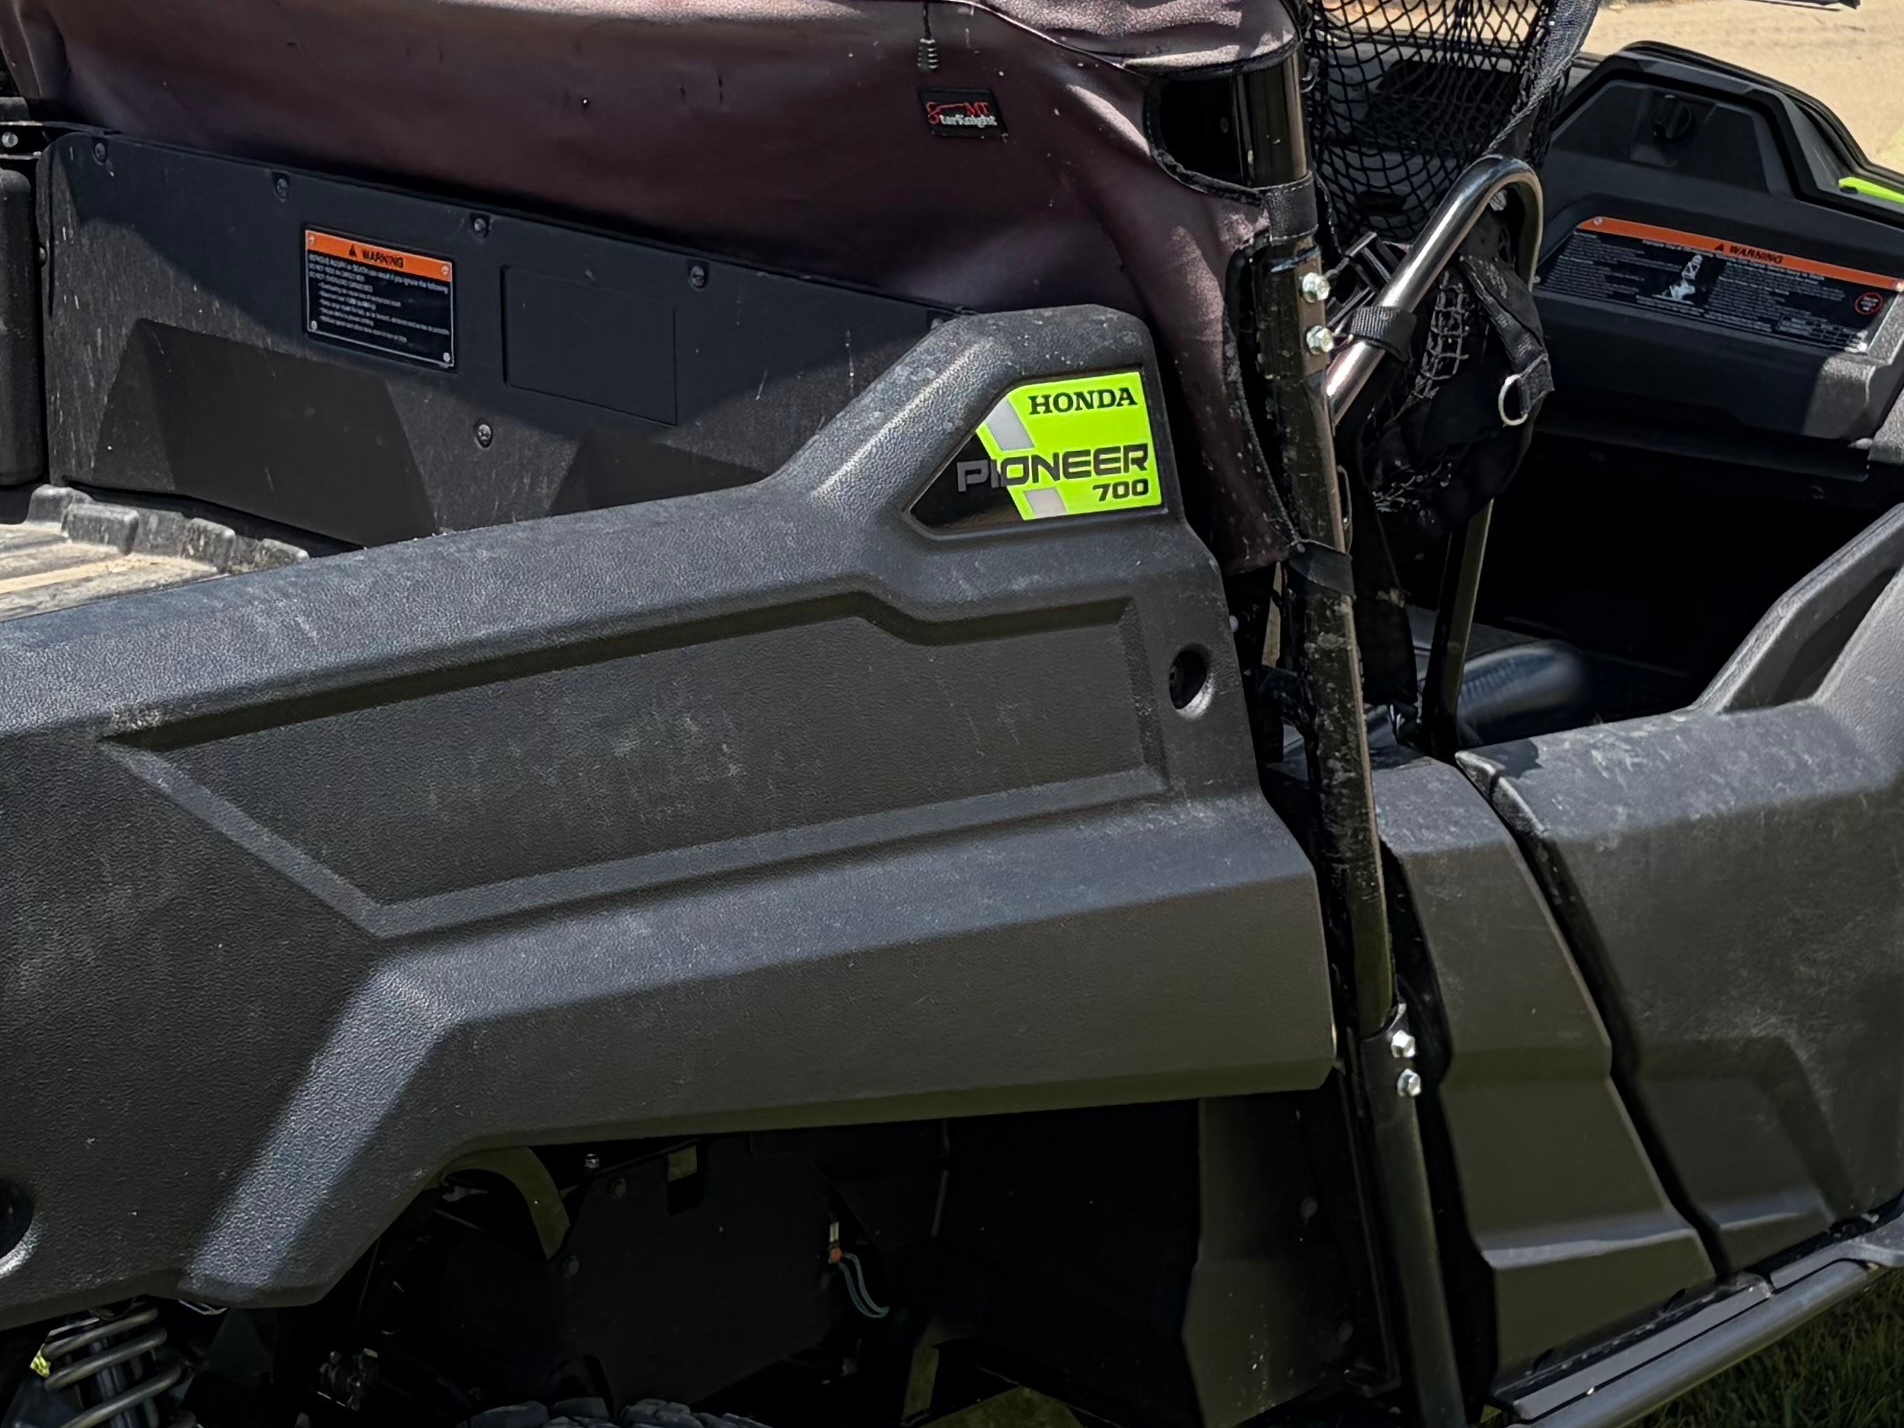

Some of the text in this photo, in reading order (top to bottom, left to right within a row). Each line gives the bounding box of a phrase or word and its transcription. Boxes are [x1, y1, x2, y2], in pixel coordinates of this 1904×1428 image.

[361, 248, 405, 269] WARNING
[1729, 245, 1785, 264] WARNING
[1027, 387, 1139, 416] HONDA
[956, 443, 1149, 493] PIONEER
[1092, 479, 1149, 503] 700
